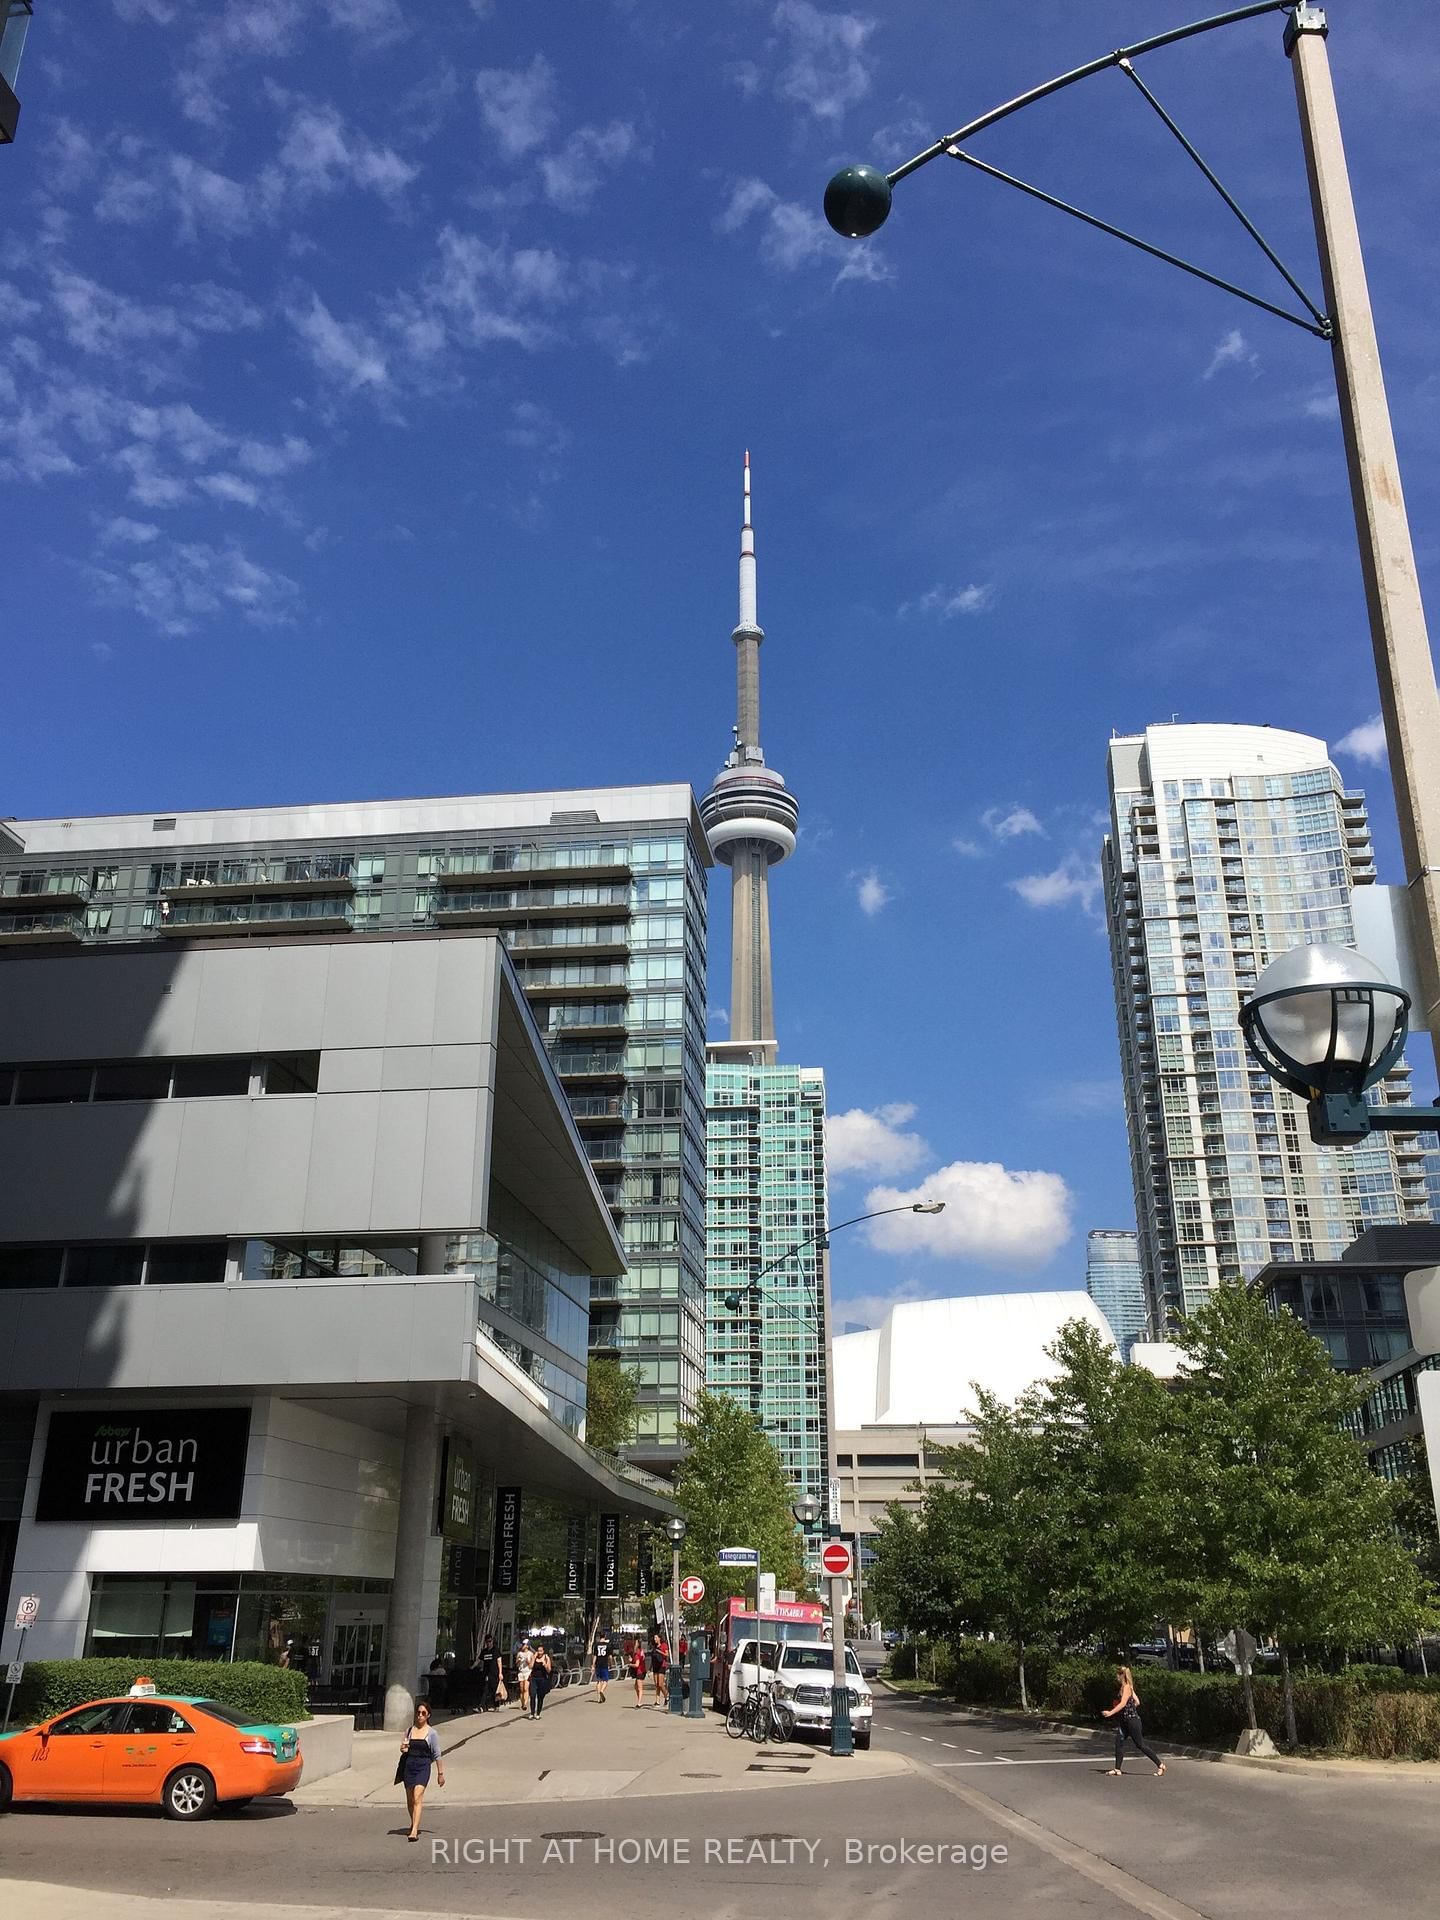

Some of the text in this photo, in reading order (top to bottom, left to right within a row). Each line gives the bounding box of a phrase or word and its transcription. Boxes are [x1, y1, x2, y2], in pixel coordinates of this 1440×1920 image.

[91, 1427, 198, 1465] urban
[85, 1472, 195, 1503] FRESH
[453, 1463, 471, 1493] urban
[451, 1494, 470, 1525] FRESH
[688, 1580, 703, 1599] P
